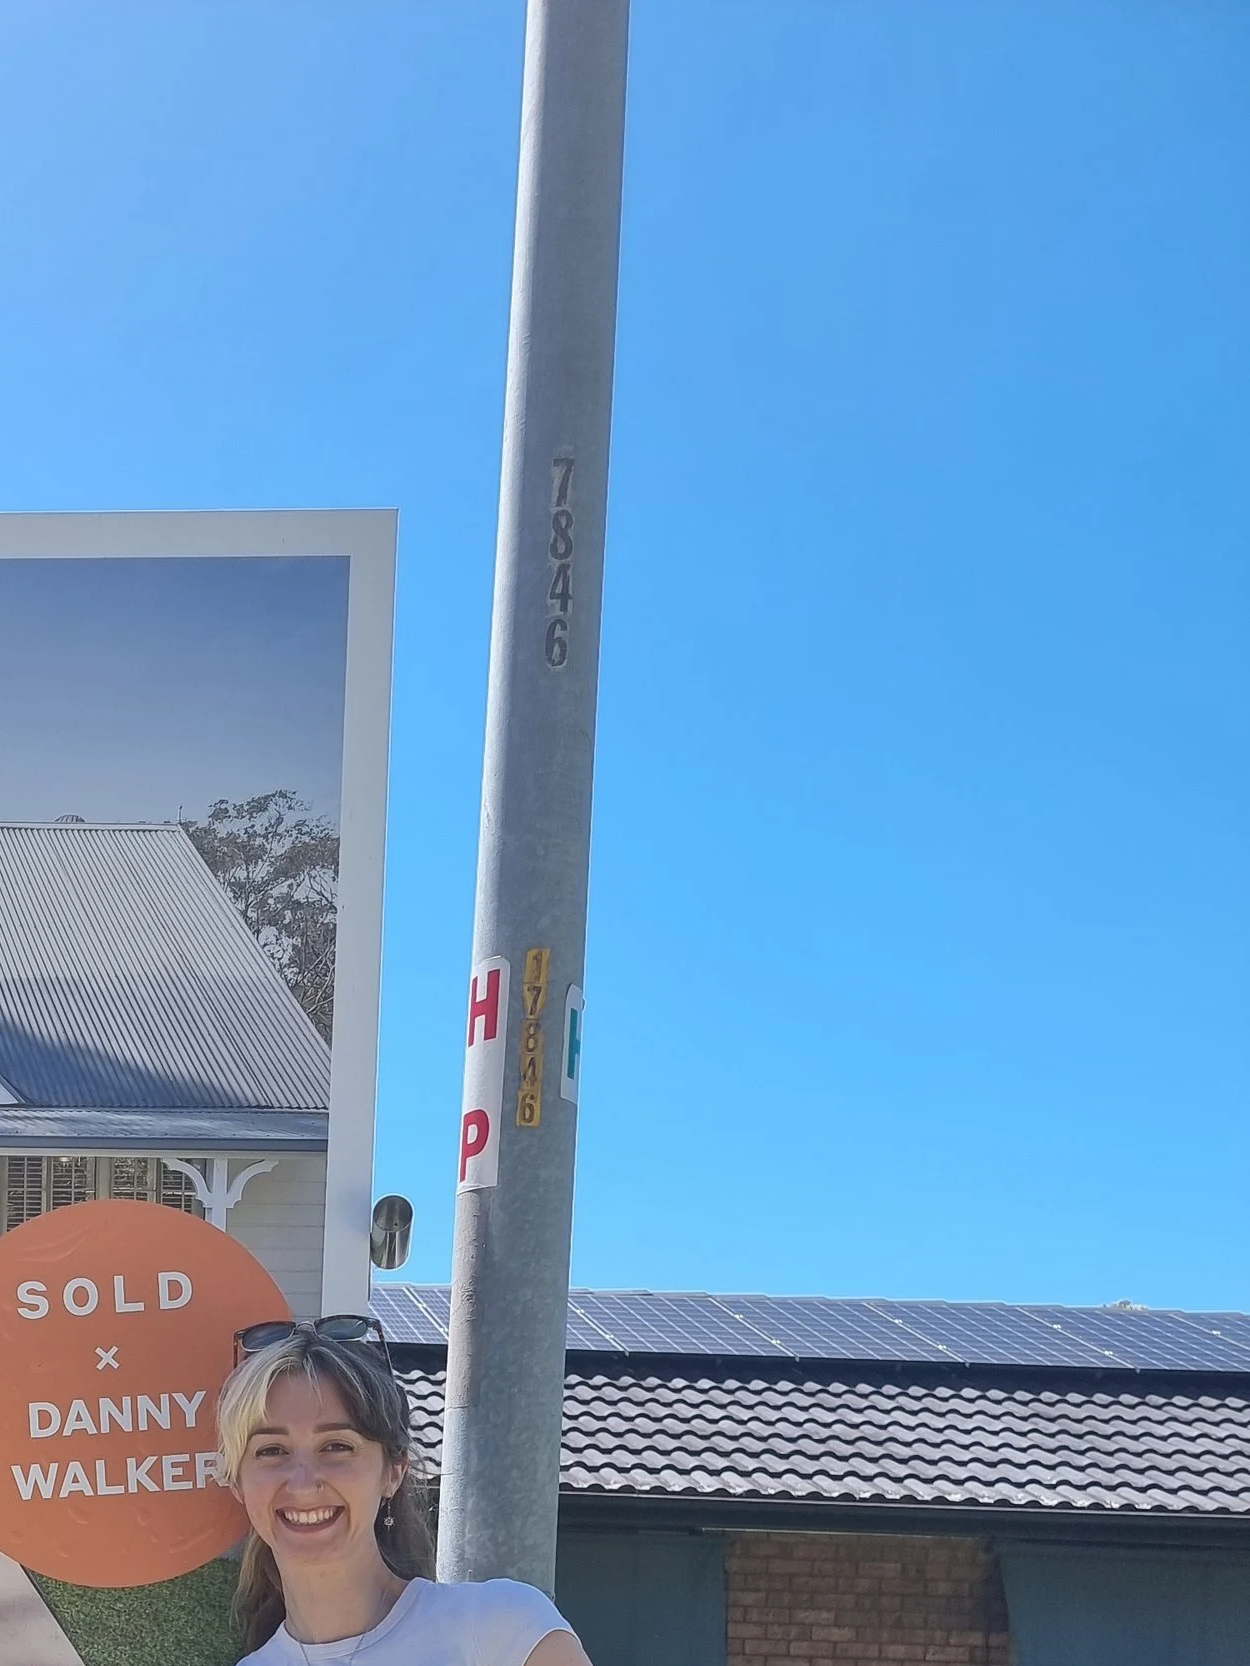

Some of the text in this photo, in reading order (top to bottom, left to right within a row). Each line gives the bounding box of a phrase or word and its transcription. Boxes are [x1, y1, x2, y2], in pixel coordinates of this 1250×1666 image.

[545, 457, 574, 667] 7846
[16, 1271, 193, 1320] SOLD
[28, 1390, 206, 1438] DANNY
[11, 1451, 231, 1501] WALKER
